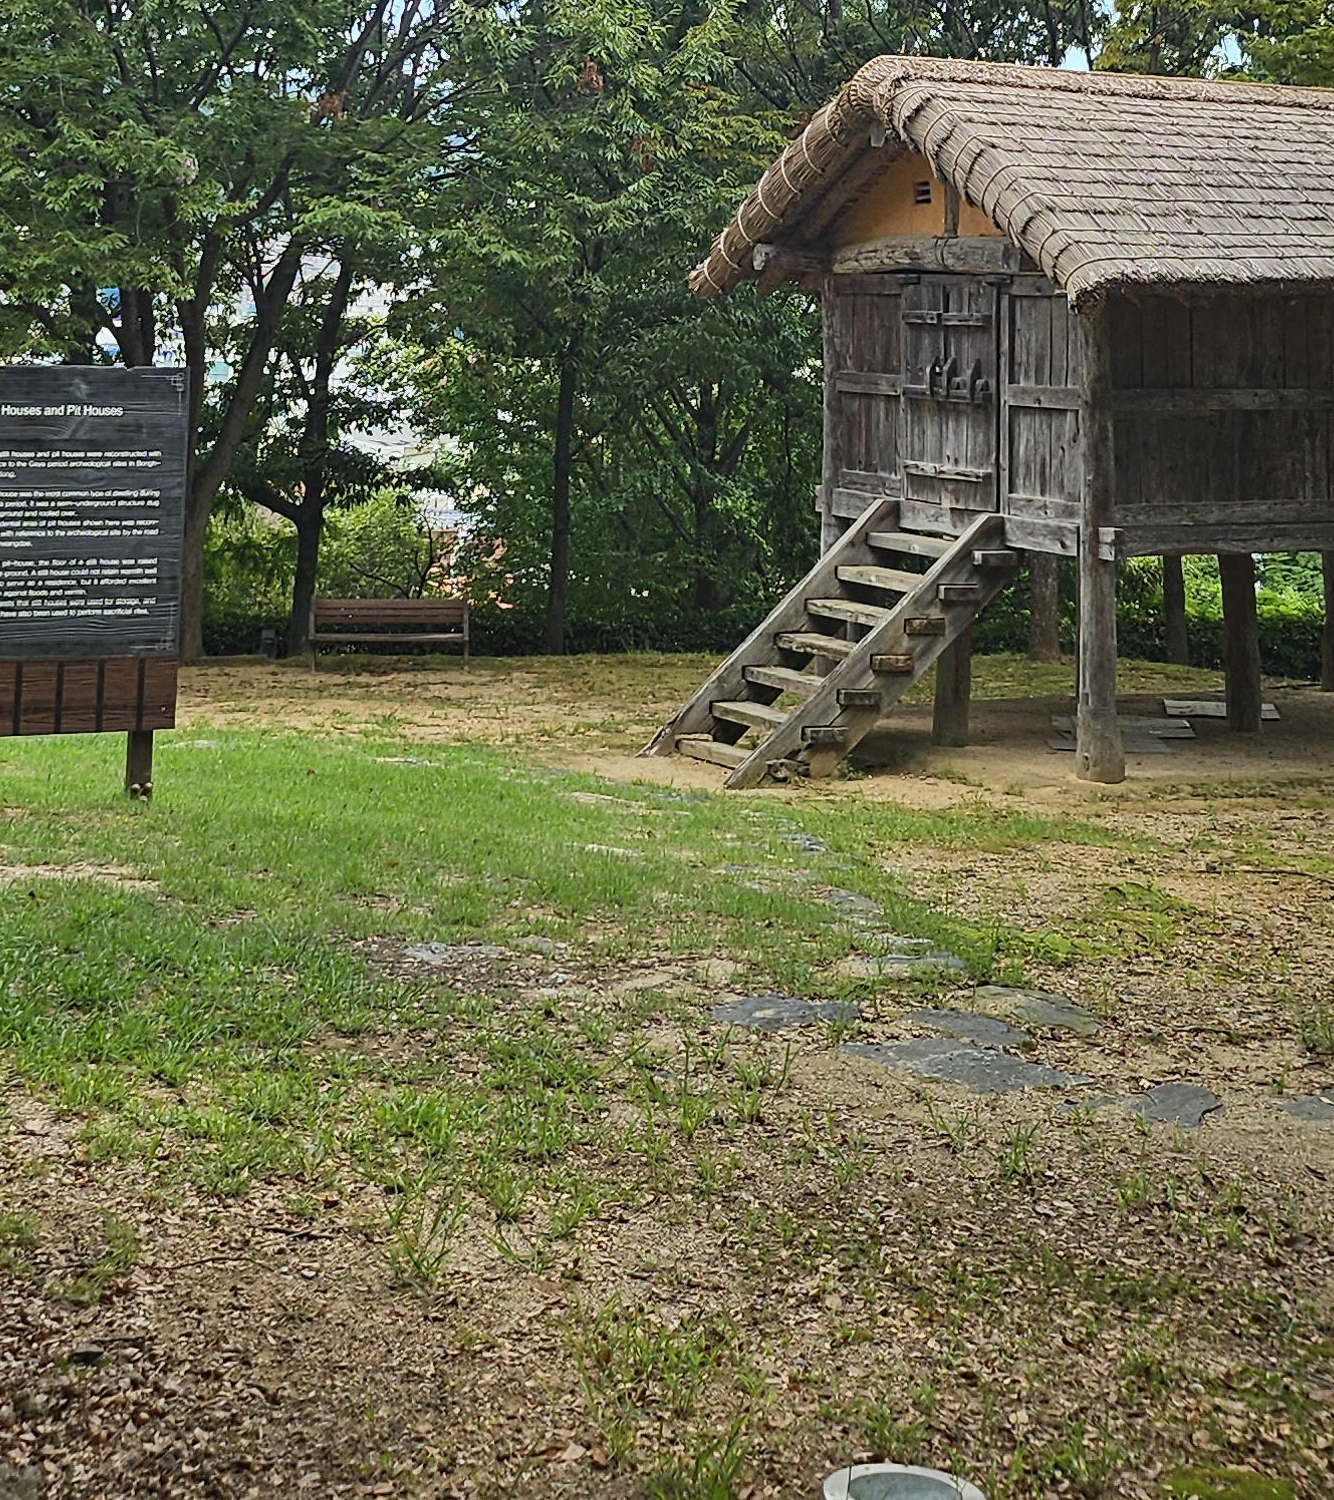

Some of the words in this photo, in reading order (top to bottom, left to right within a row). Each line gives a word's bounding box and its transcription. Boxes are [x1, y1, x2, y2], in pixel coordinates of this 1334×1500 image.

[0, 404, 42, 416] Houses
[66, 404, 82, 416] Pit
[83, 404, 124, 416] Houses
